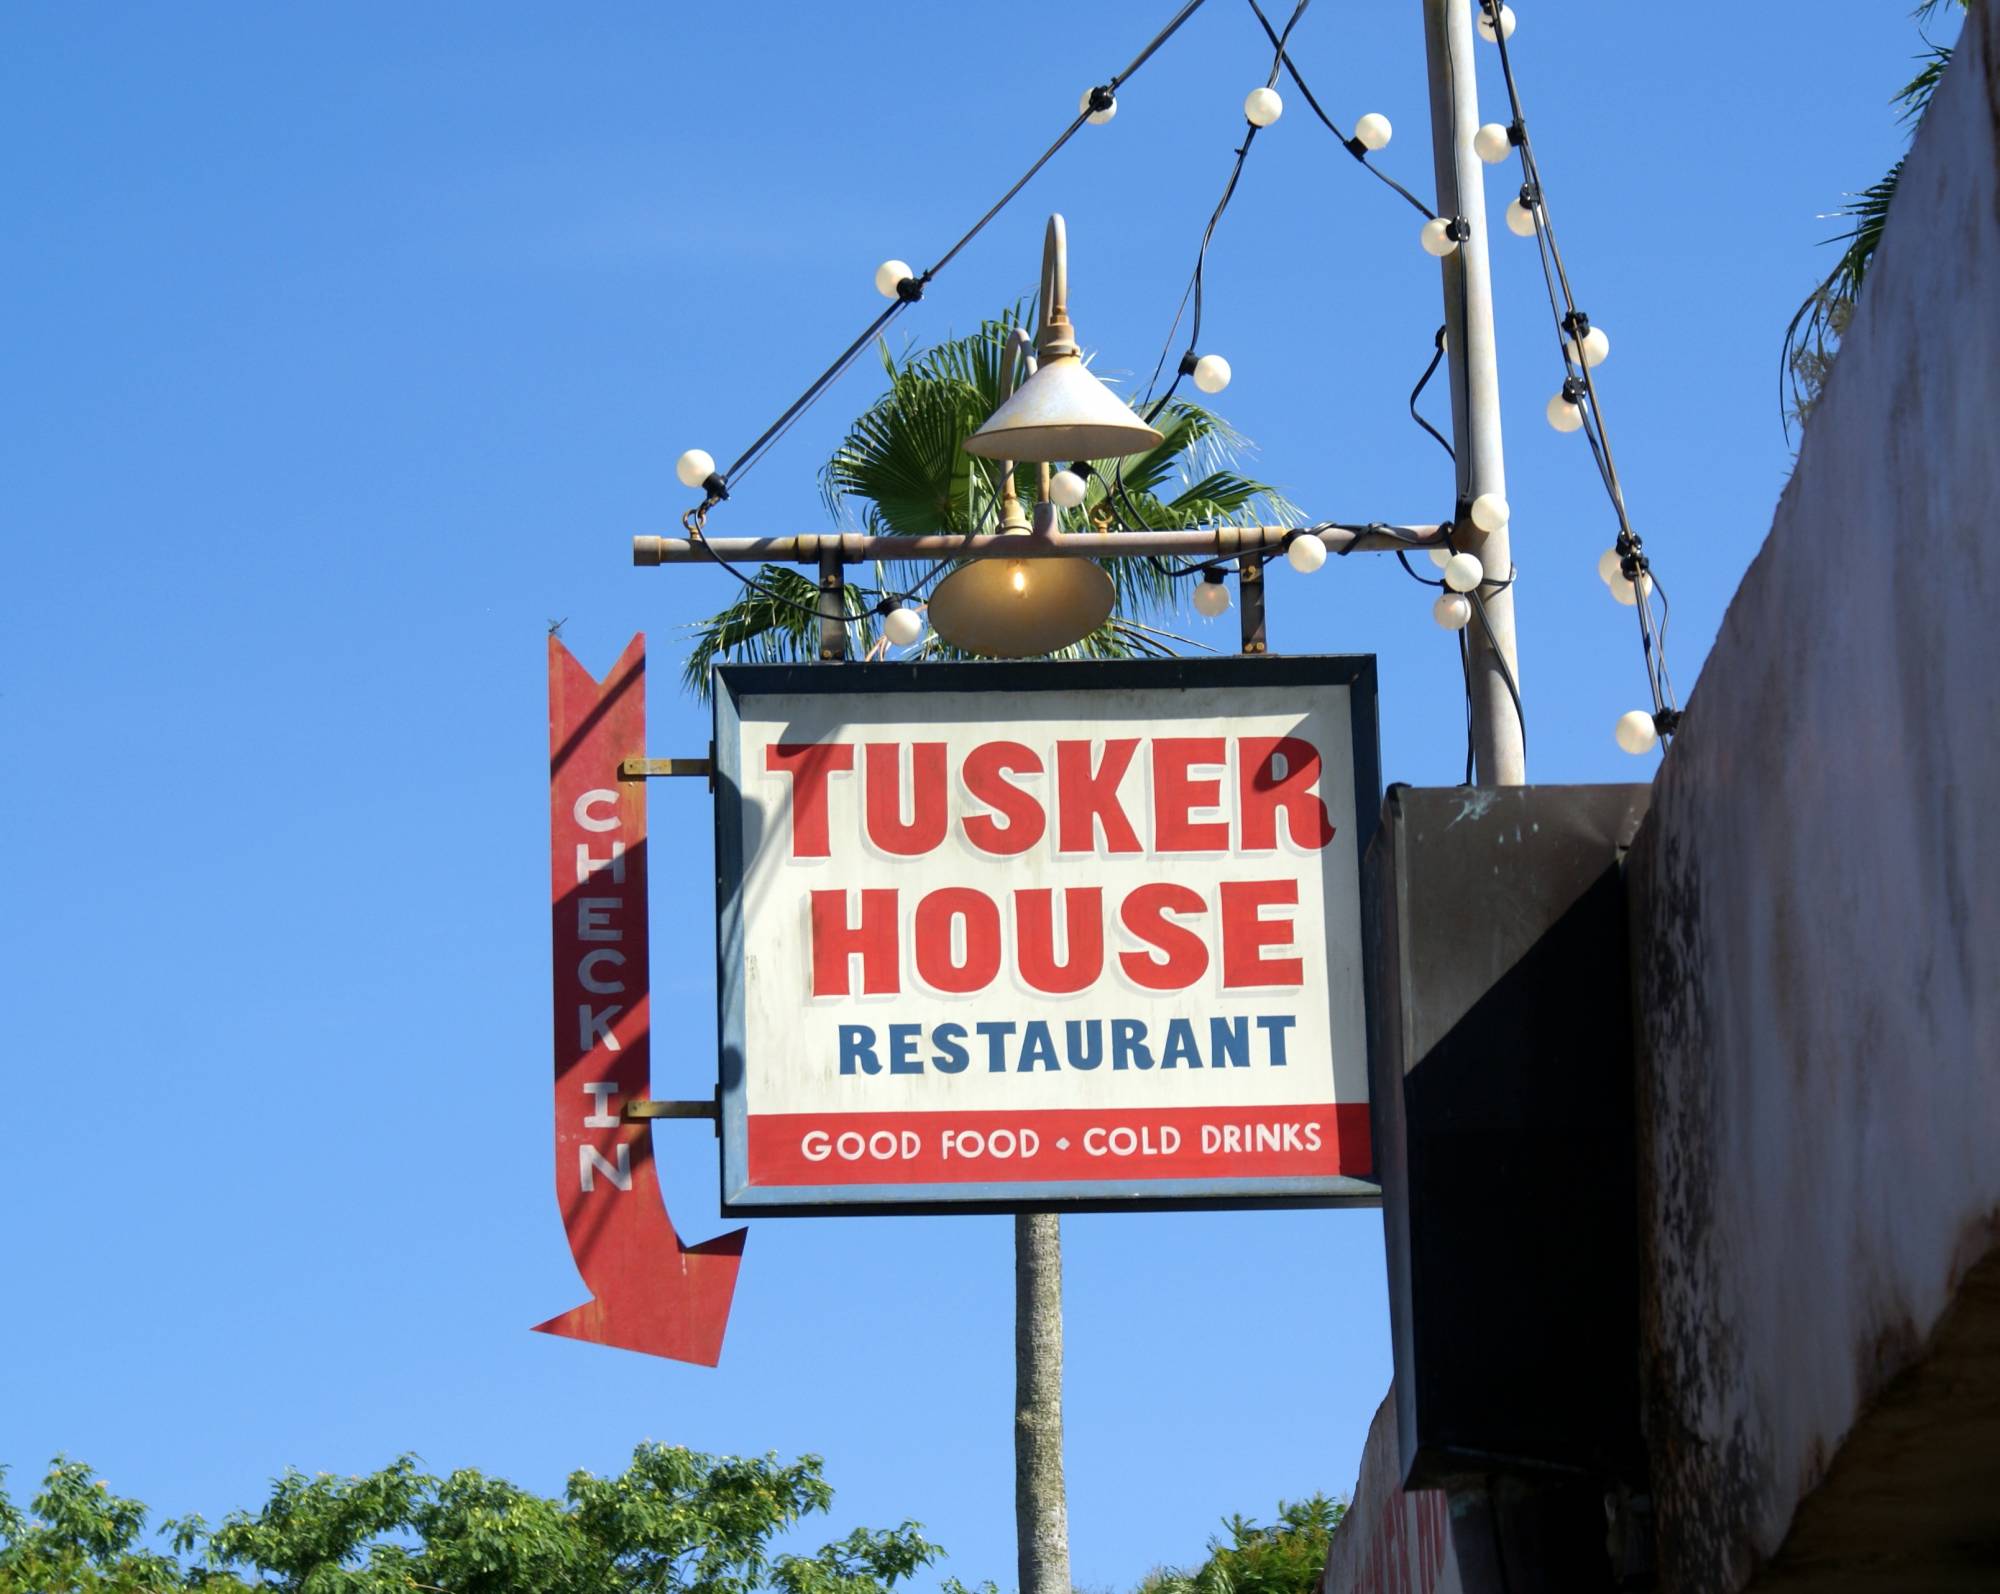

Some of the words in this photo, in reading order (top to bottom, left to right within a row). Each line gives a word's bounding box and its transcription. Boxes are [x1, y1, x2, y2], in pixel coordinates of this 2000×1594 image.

[766, 737, 1336, 858] TUSKER
[573, 789, 627, 1051] CHECK
[811, 879, 1304, 997] HOUSE
[839, 1015, 1296, 1075] RESTAURANT
[579, 1082, 634, 1193] IN
[802, 1131, 921, 1161] GOOD
[942, 1129, 1039, 1159] FOOD
[1083, 1126, 1181, 1156] COLD
[1202, 1122, 1321, 1154] DRINKS
